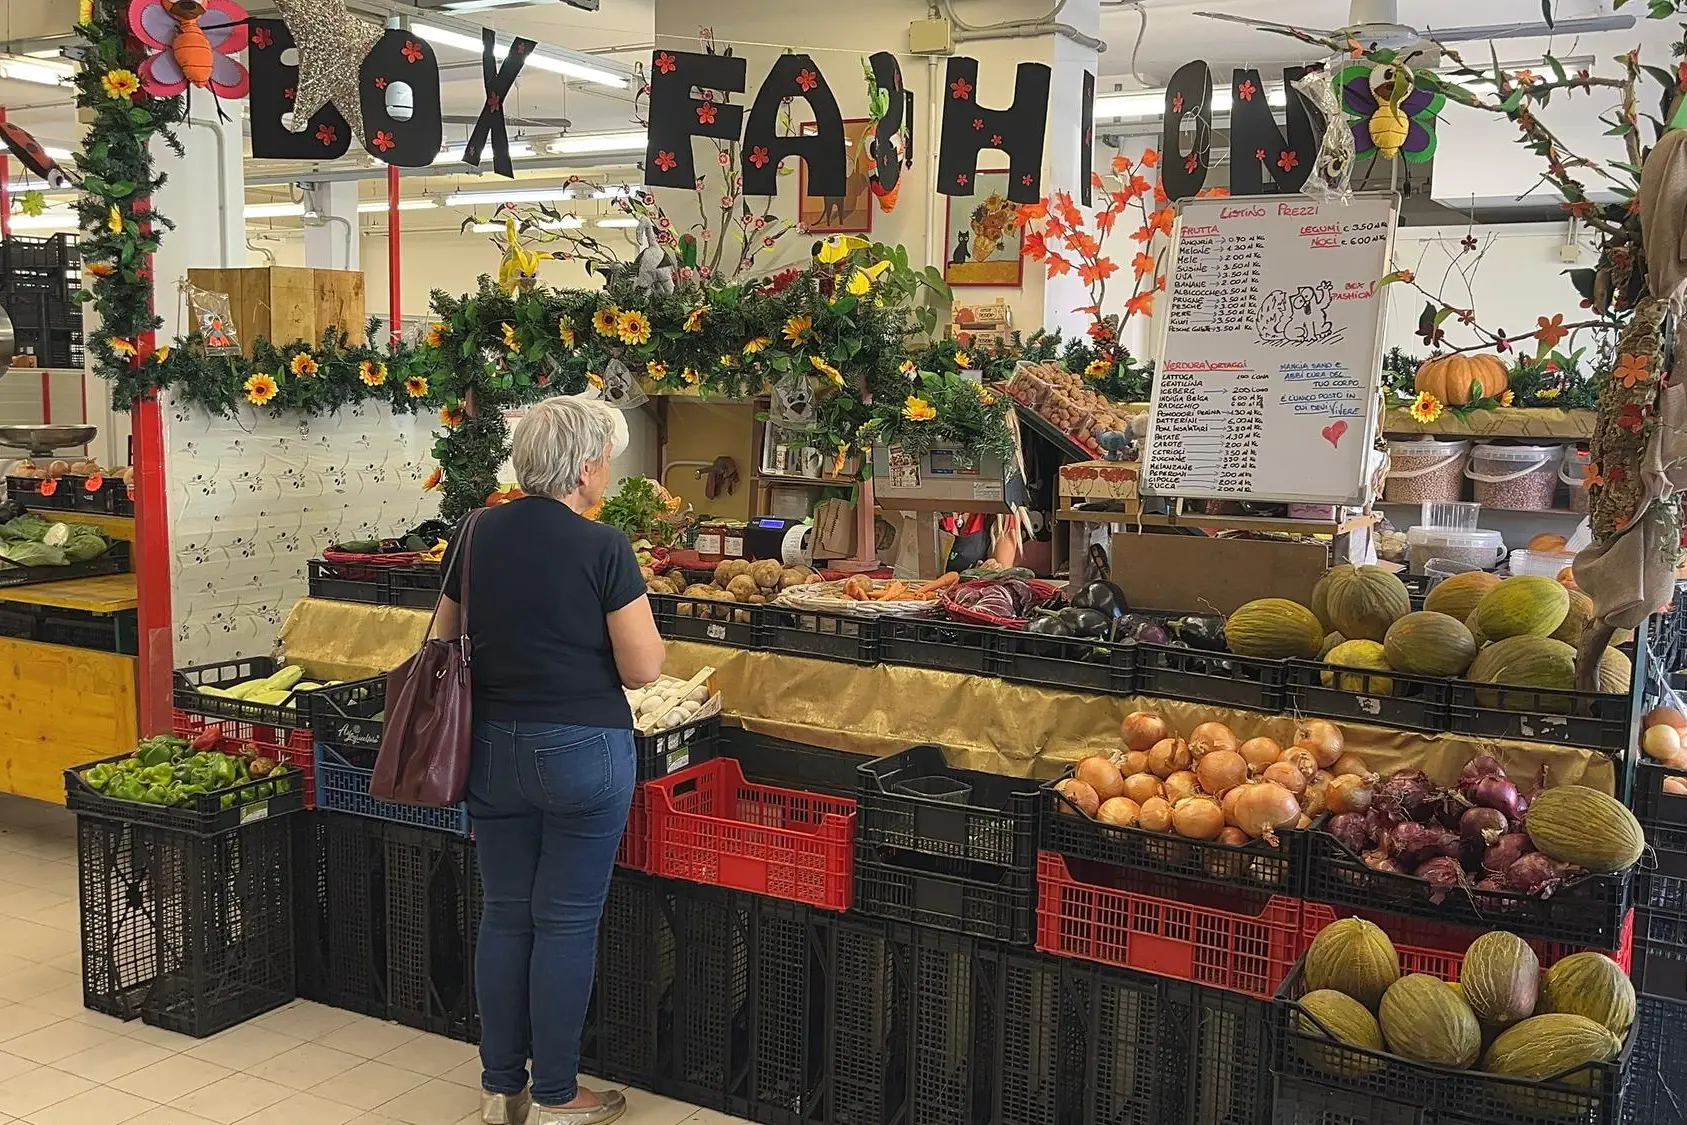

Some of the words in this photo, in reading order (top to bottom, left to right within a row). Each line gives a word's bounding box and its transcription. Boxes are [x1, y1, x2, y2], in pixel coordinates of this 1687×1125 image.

[249, 17, 537, 178] BOX
[1220, 204, 1266, 219] LISTINO
[1278, 203, 1319, 217] PREZZI
[1180, 225, 1219, 236] FRUTTA
[1300, 222, 1340, 234] LEGUMI
[1181, 238, 1213, 246] ANGURIA
[1311, 234, 1337, 246] NOCI
[1176, 263, 1208, 272] SUSINE
[1175, 273, 1193, 281] UVA
[1173, 289, 1220, 297] ALBICOCCHE
[1170, 310, 1191, 318] PERE
[1170, 317, 1189, 325] KIWI
[1346, 390, 1355, 398] IN
[1154, 433, 1180, 441] PATATE
